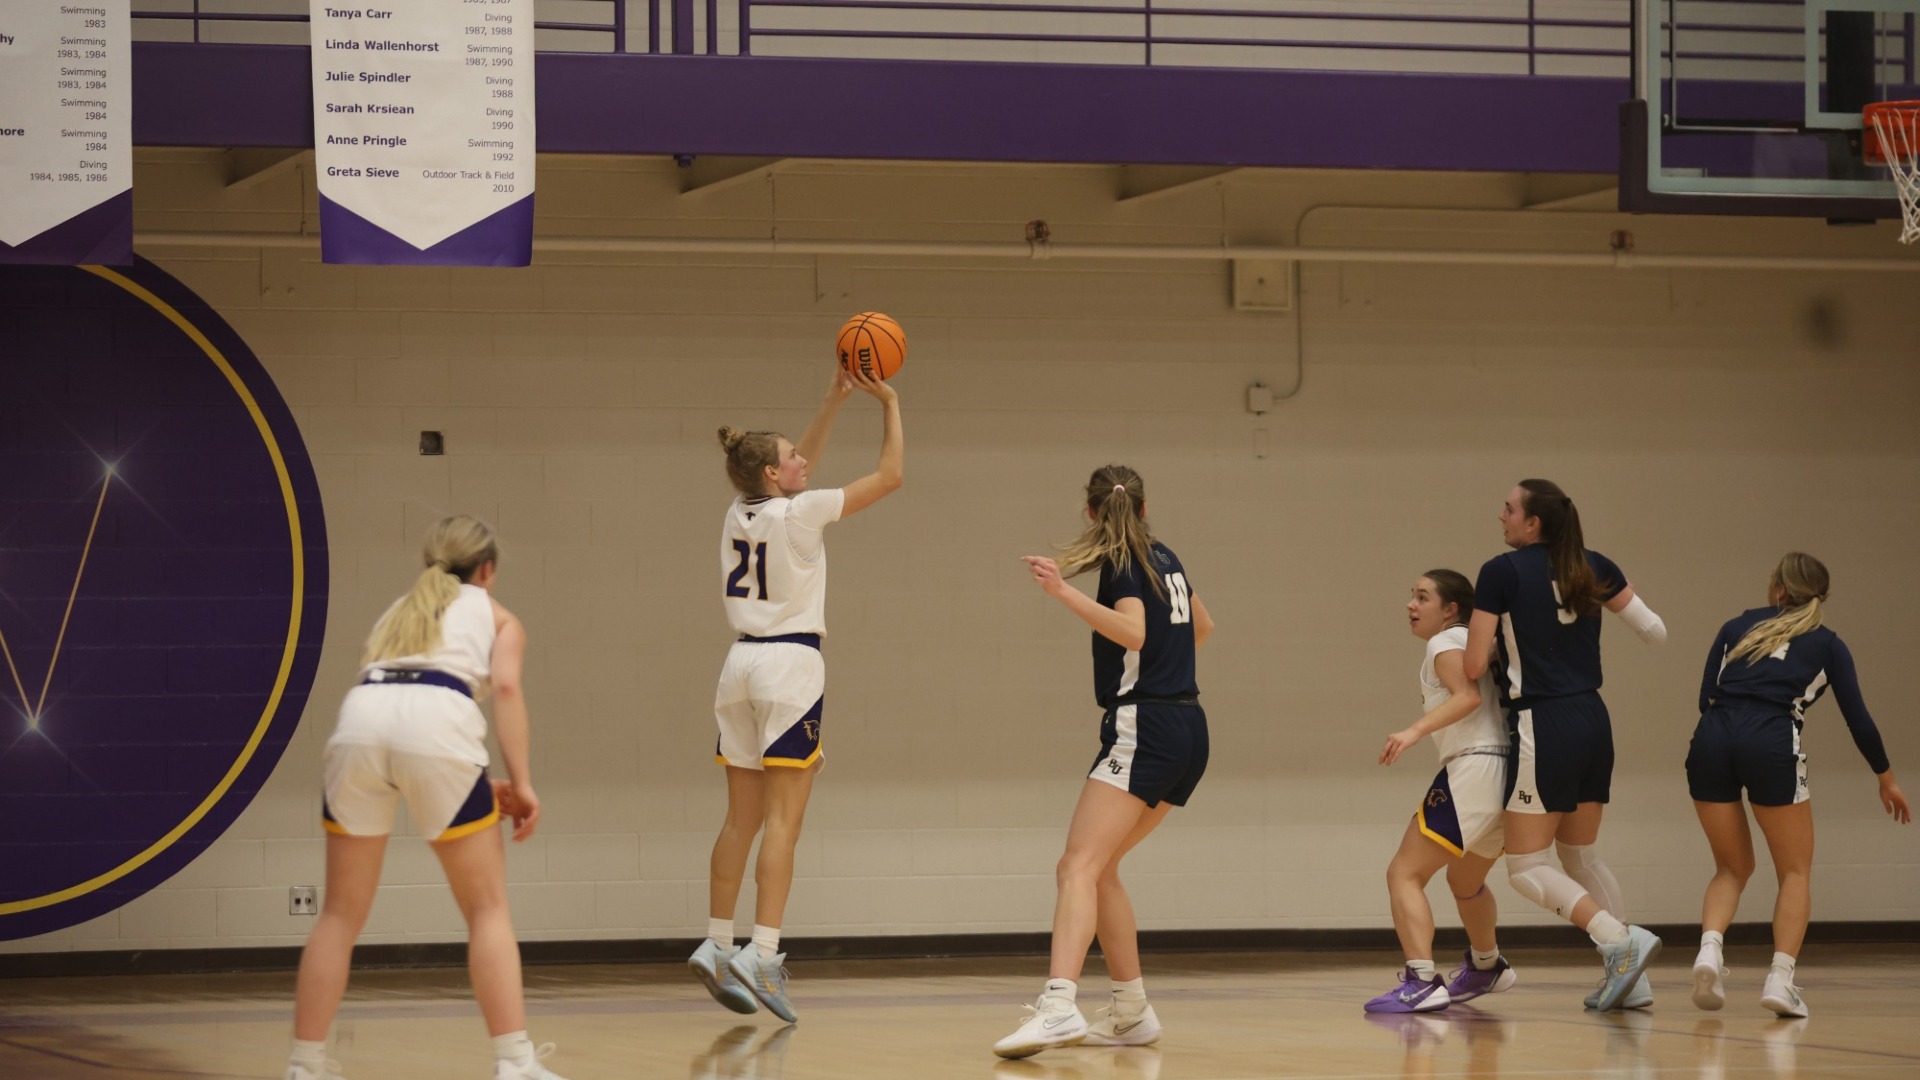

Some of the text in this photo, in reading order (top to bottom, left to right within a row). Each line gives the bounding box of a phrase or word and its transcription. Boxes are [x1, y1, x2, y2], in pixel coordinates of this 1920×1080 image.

[61, 6, 106, 17] Swimming
[325, 8, 392, 20] Tanya Carr
[485, 14, 512, 23] Diving
[84, 20, 106, 28] 1983
[464, 27, 513, 36] 1987, 1988
[61, 37, 106, 47] Swimming
[326, 40, 439, 52] Linda Wallenhorst
[467, 45, 513, 54] Swimming
[57, 50, 106, 59] 1983, 1984
[465, 58, 513, 67] 1987, 1990
[61, 68, 106, 78] Swimming
[326, 72, 411, 84] Julie Spindler
[486, 77, 513, 86] Diving
[57, 81, 82, 89] 1983,
[492, 90, 513, 98] 1988
[61, 99, 107, 109] Swimming
[326, 104, 414, 114] Sarah Krsiean
[486, 108, 514, 118] Diving
[85, 112, 106, 120] 1984
[492, 122, 514, 130] 1990
[61, 130, 107, 140] Swimming
[326, 135, 407, 147] Anne Pringle
[468, 139, 514, 149] Swimming
[85, 143, 107, 151] 1984
[492, 153, 514, 161] 1992
[80, 161, 107, 170] Diving
[327, 167, 399, 178] Greta Sieve
[422, 170, 514, 179] Outdoor Track & Field
[30, 173, 107, 182] 1984, 1985, 1986
[492, 184, 514, 192] 2010
[726, 538, 768, 601] 21
[1165, 572, 1190, 624] 10
[1107, 758, 1123, 775] BU
[1518, 790, 1532, 805] BU
